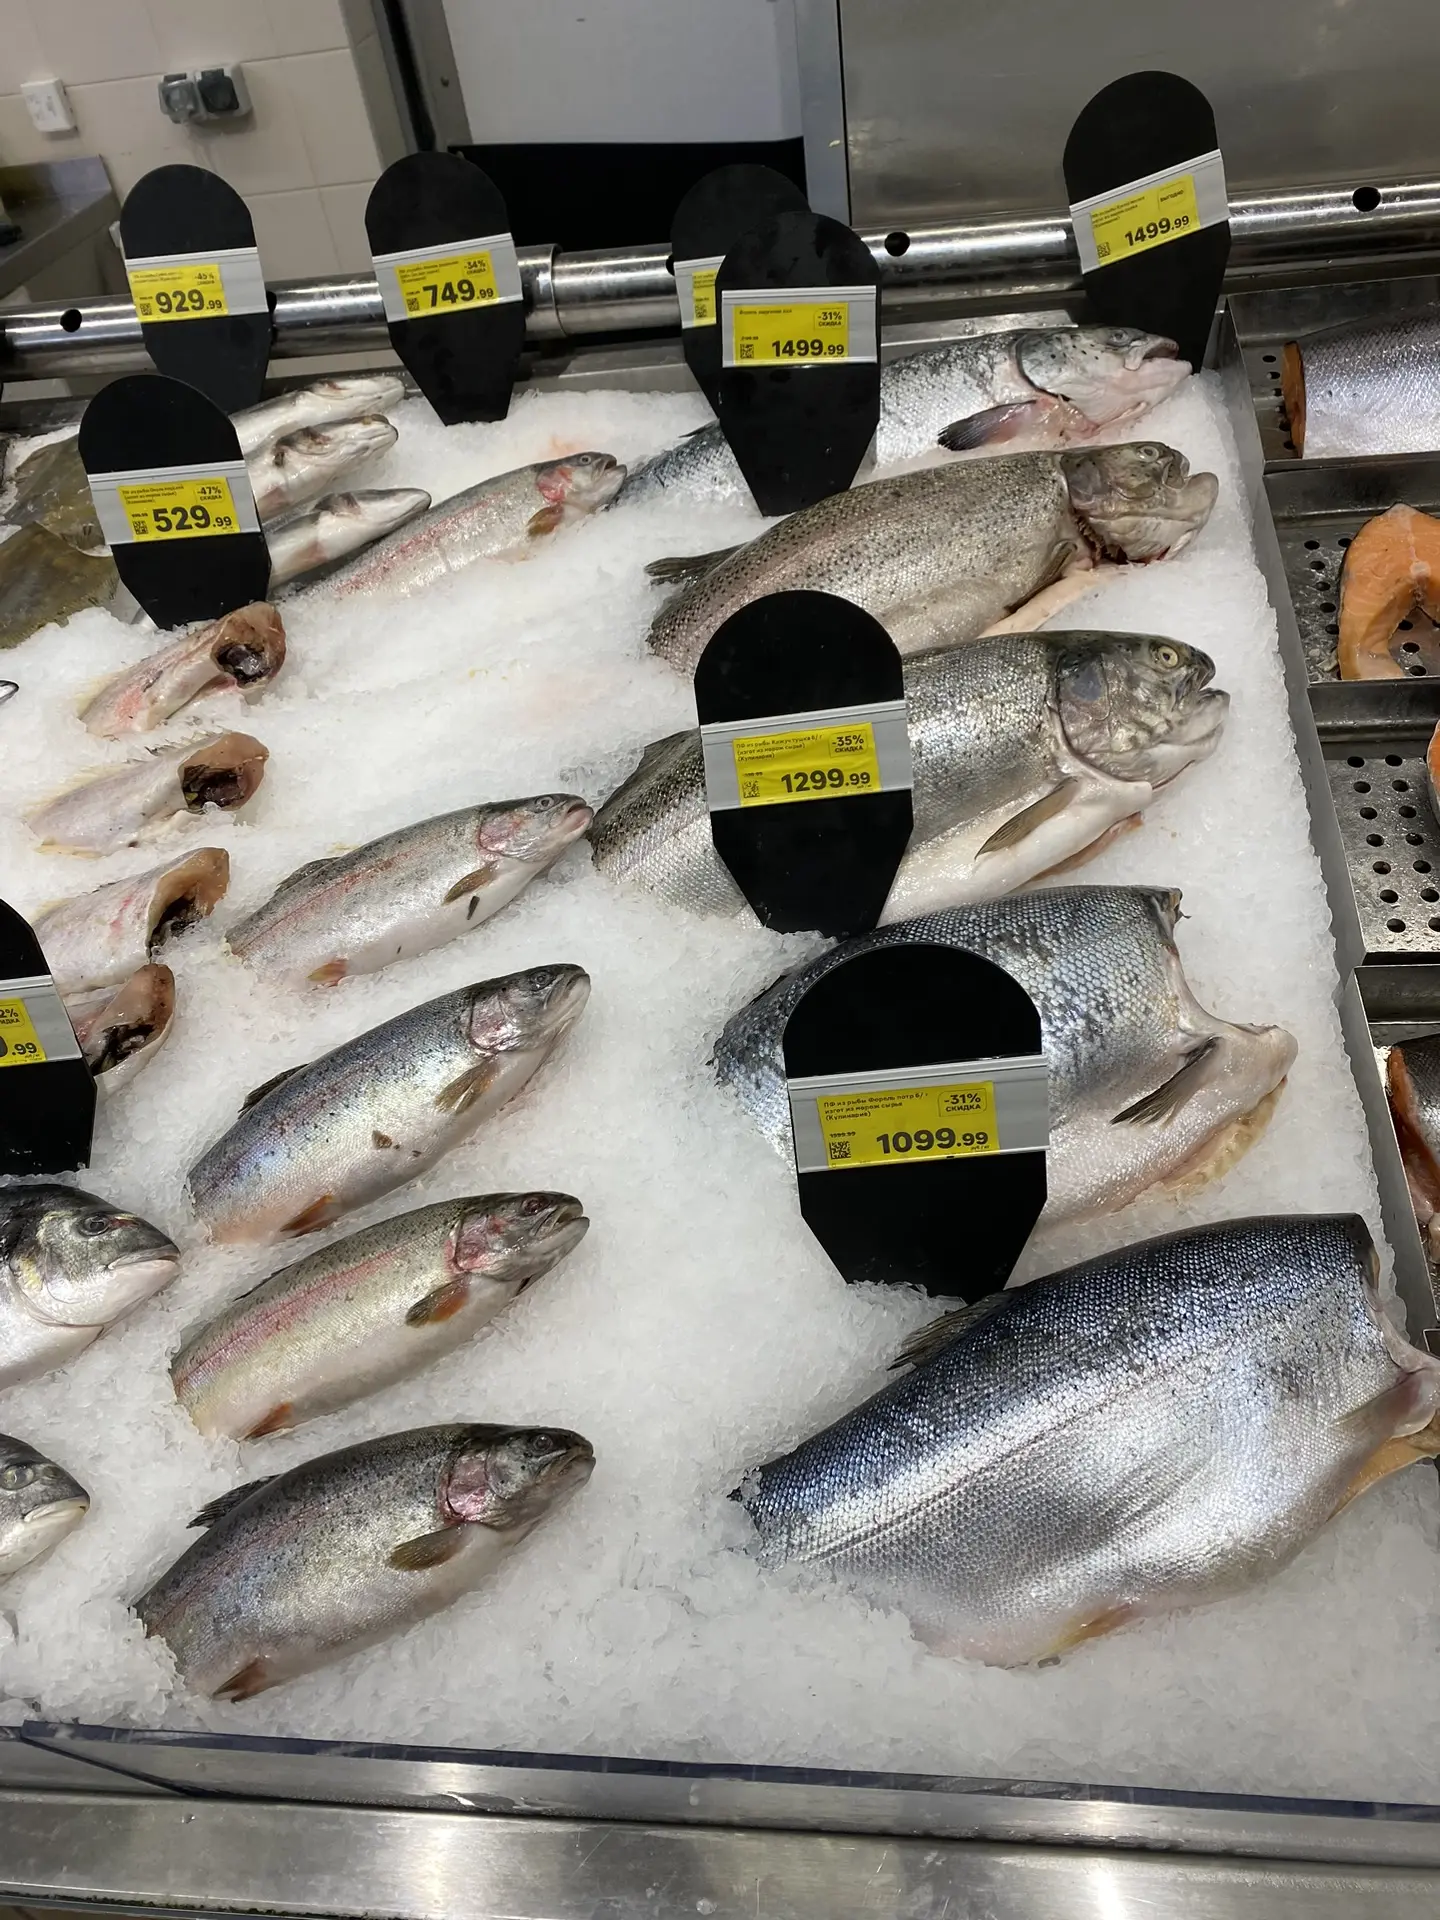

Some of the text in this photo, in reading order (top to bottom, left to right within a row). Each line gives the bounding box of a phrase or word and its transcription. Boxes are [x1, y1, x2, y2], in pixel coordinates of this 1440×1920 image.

[1124, 215, 1189, 246] 1499.99
[464, 259, 486, 270] -34%
[422, 279, 494, 308] 749.99
[155, 289, 222, 313] 929.99
[818, 311, 842, 321] -31%
[772, 339, 844, 357] 1499.99
[197, 486, 222, 495] -47%
[152, 505, 232, 532] 529.99
[832, 734, 864, 747] -35%
[834, 745, 863, 753] СКИДКА
[781, 768, 870, 793] 1299.99
[847, 1098, 867, 1106] рыбы
[944, 1092, 981, 1105] -31%
[945, 1104, 981, 1112] СКИДКА
[825, 1111, 871, 1121] (Кулинария)
[876, 1127, 988, 1154] 1099.99
